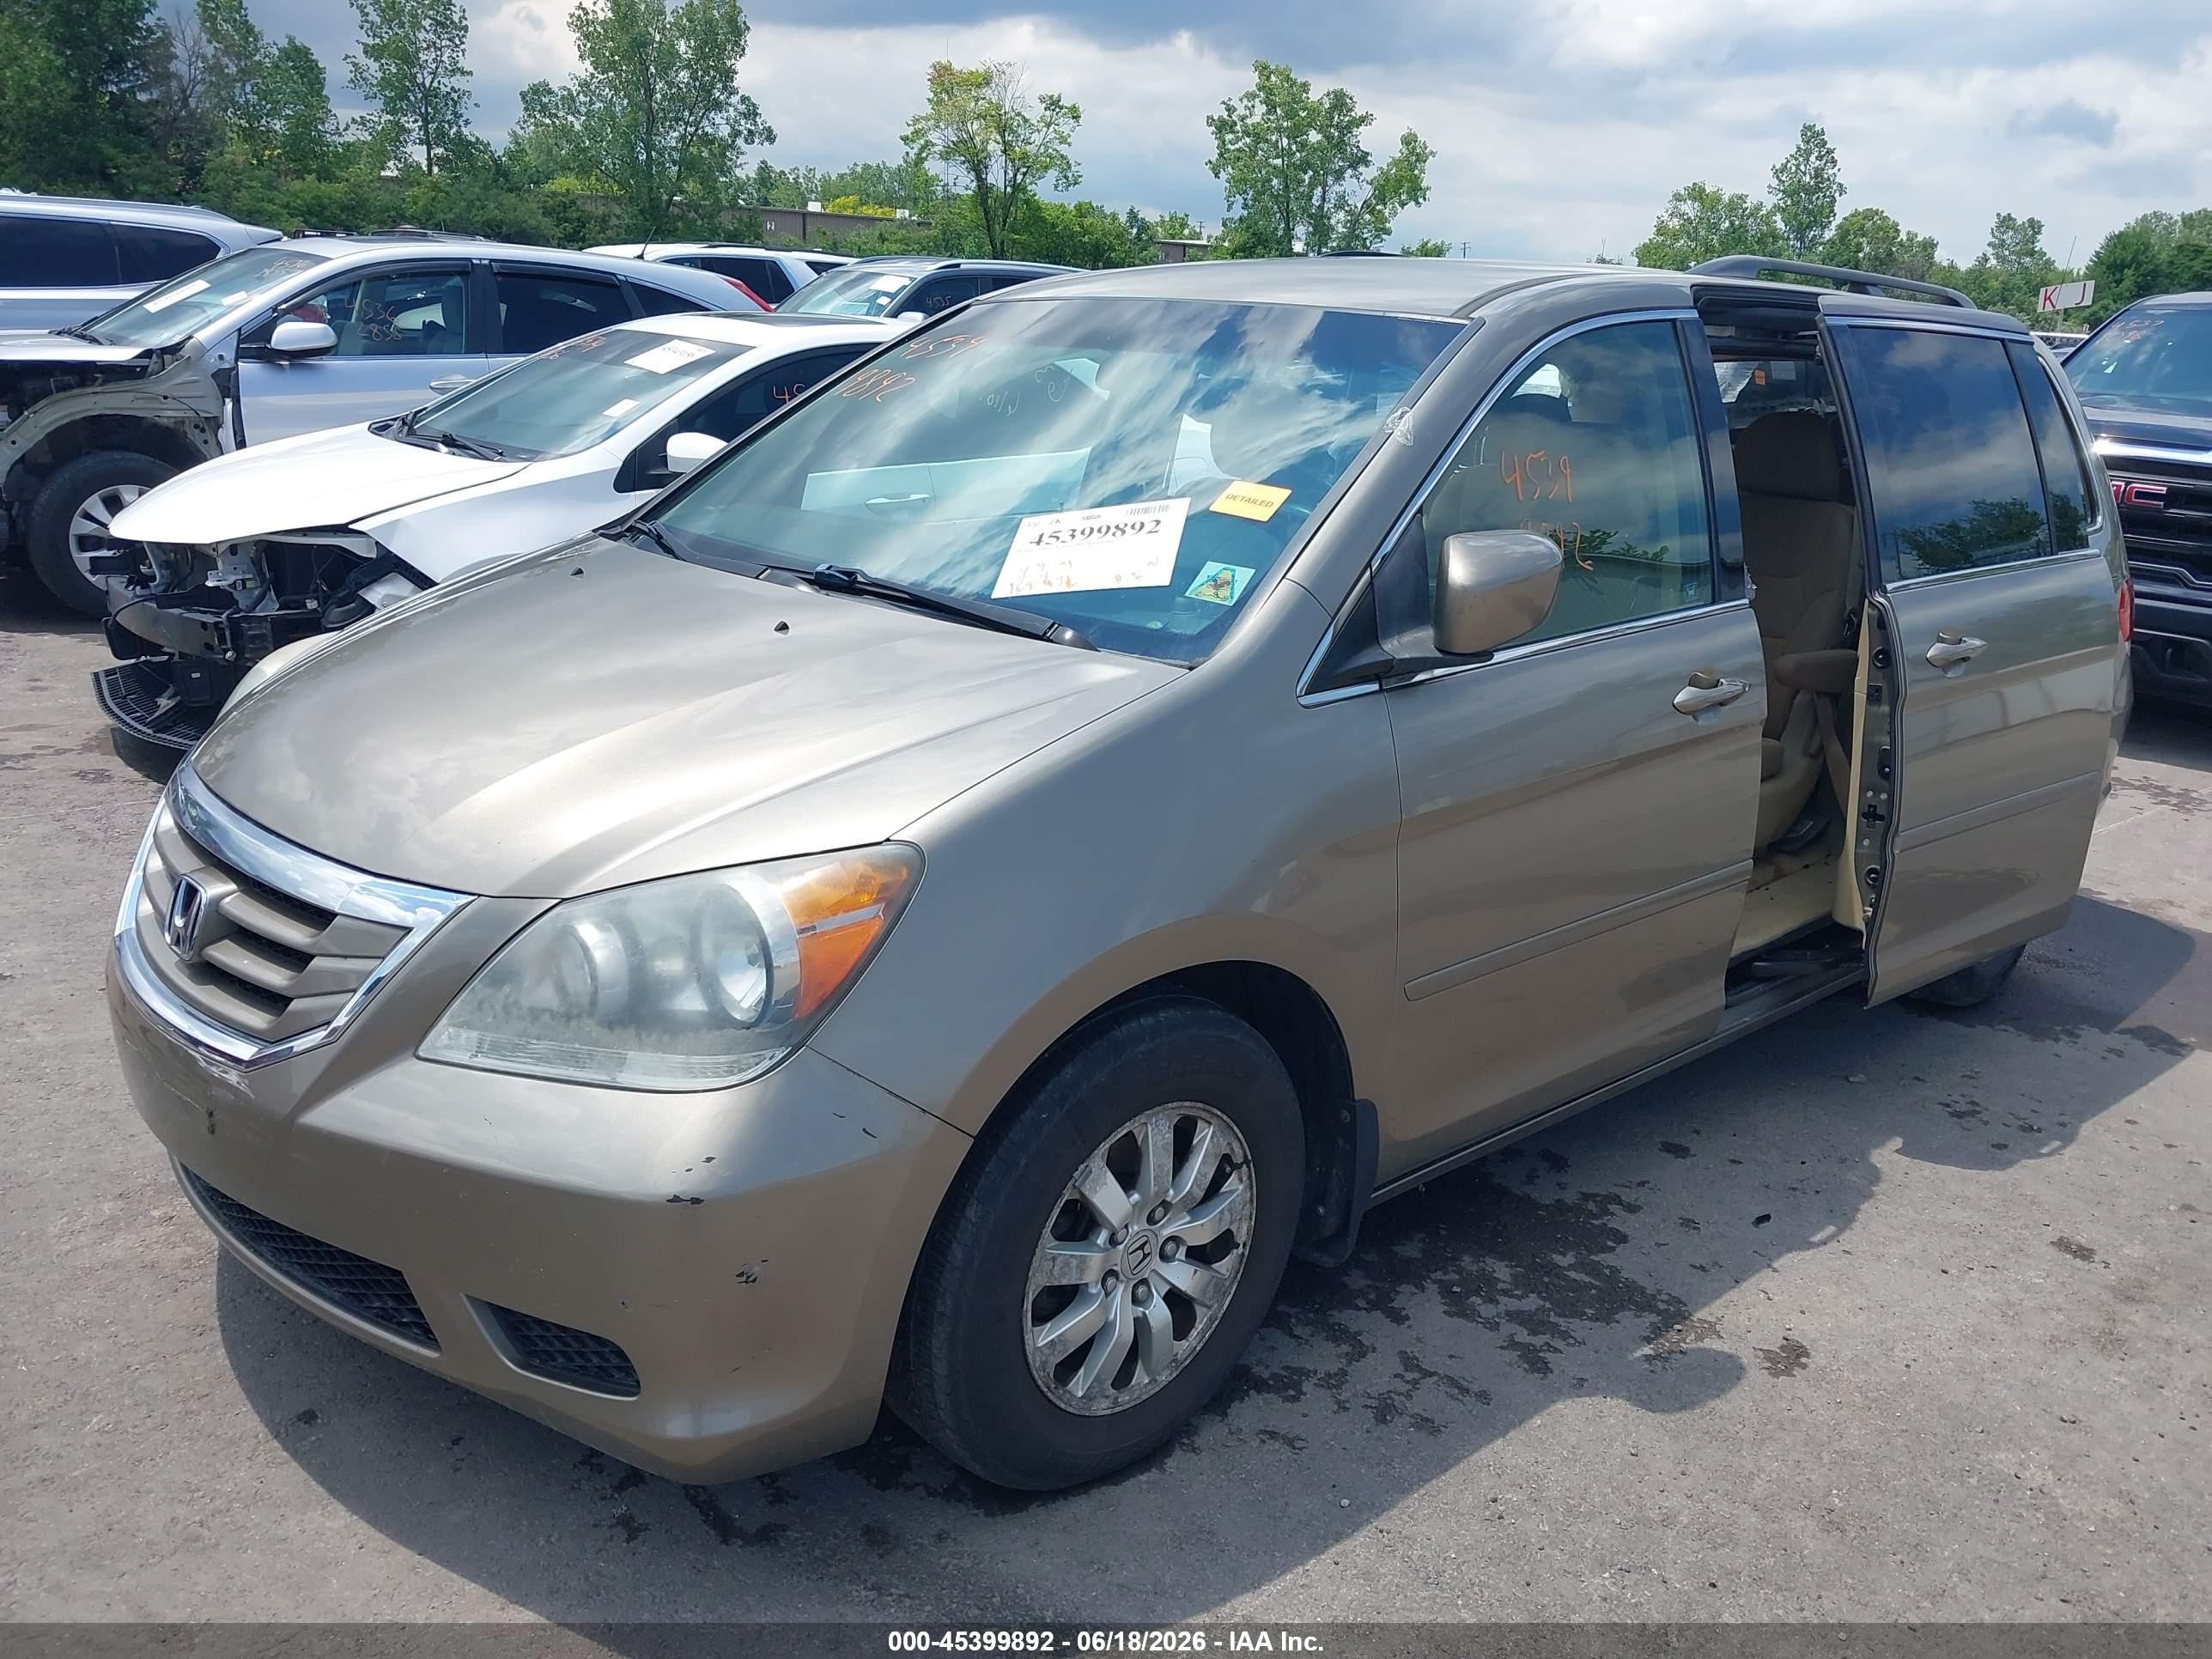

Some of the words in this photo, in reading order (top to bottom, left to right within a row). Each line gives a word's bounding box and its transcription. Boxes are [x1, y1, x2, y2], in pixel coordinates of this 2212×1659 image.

[2042, 286, 2058, 311] K
[2075, 283, 2087, 306] J
[1501, 449, 1572, 503] 4539
[1224, 493, 1274, 508] DETAILED
[1030, 518, 1163, 546] 45399892
